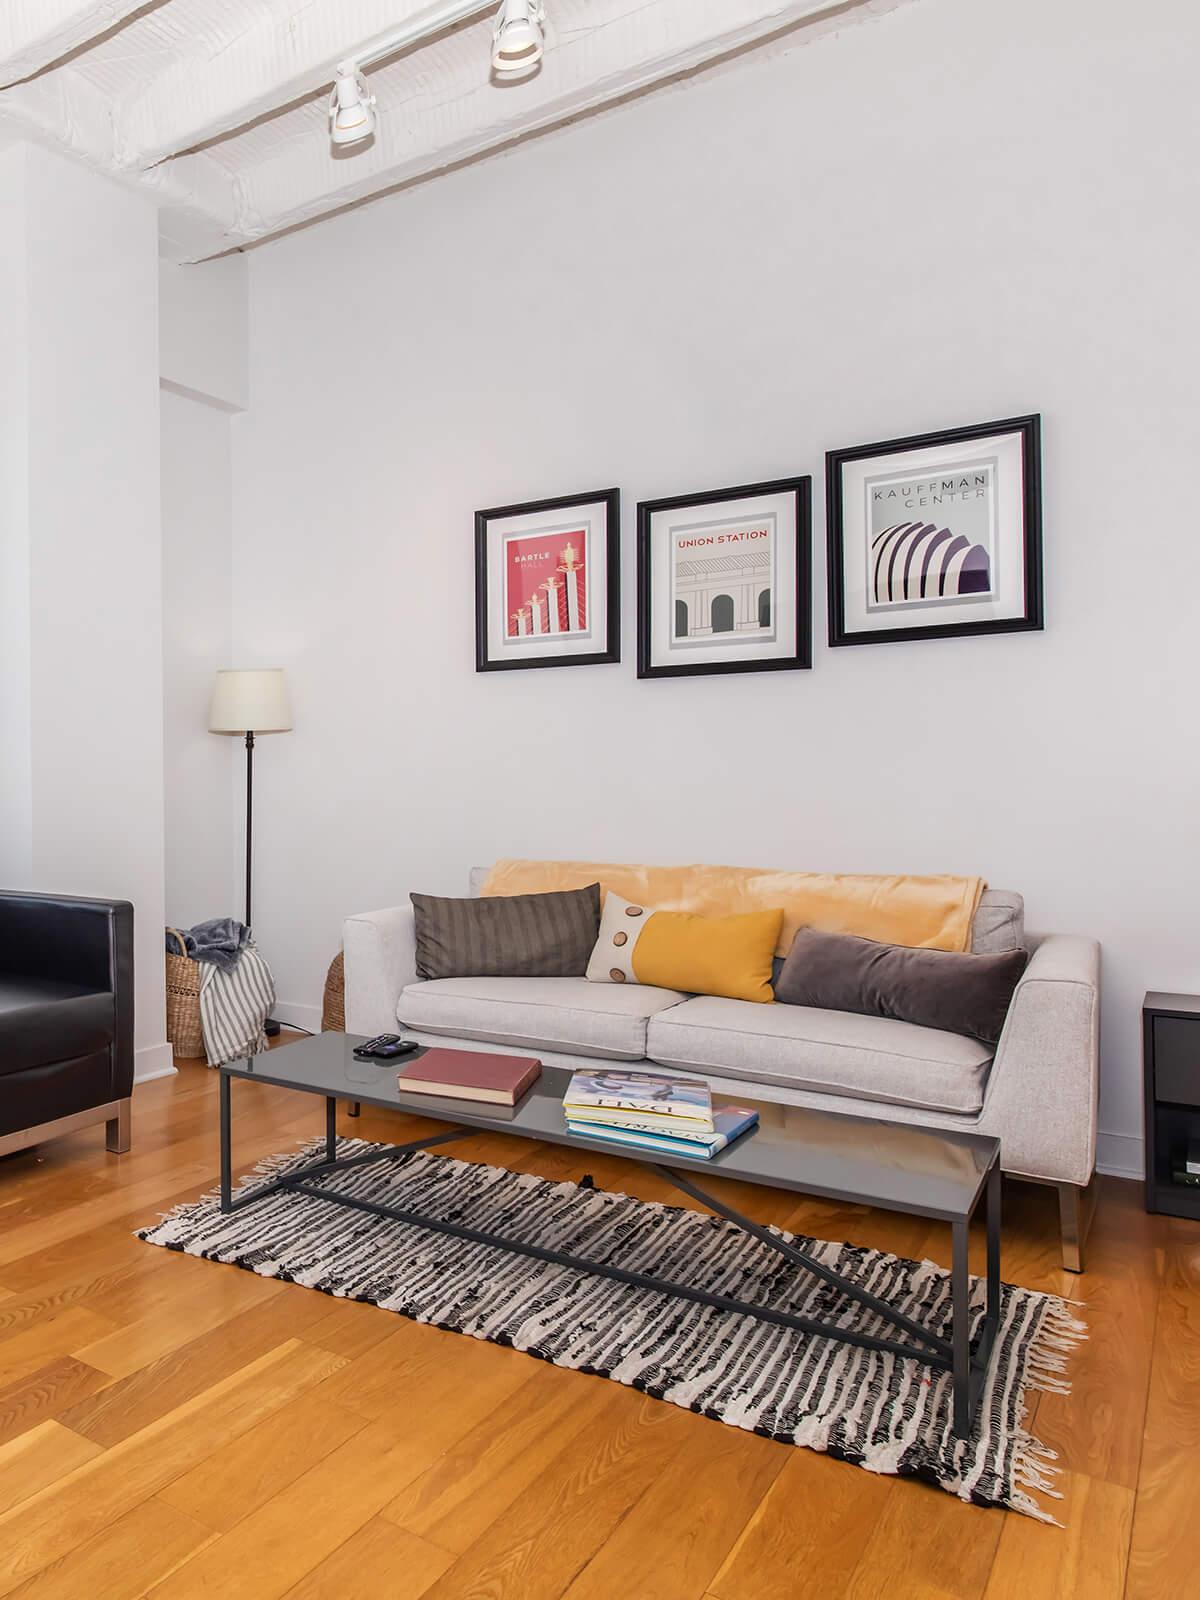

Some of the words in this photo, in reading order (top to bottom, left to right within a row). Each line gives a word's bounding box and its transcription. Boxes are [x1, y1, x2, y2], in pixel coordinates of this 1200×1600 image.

[874, 475, 985, 500] KAUFFMAN
[904, 488, 985, 508] CENTER
[678, 537, 714, 549] UNION
[717, 529, 768, 544] STATION
[514, 551, 550, 563] BARTLE
